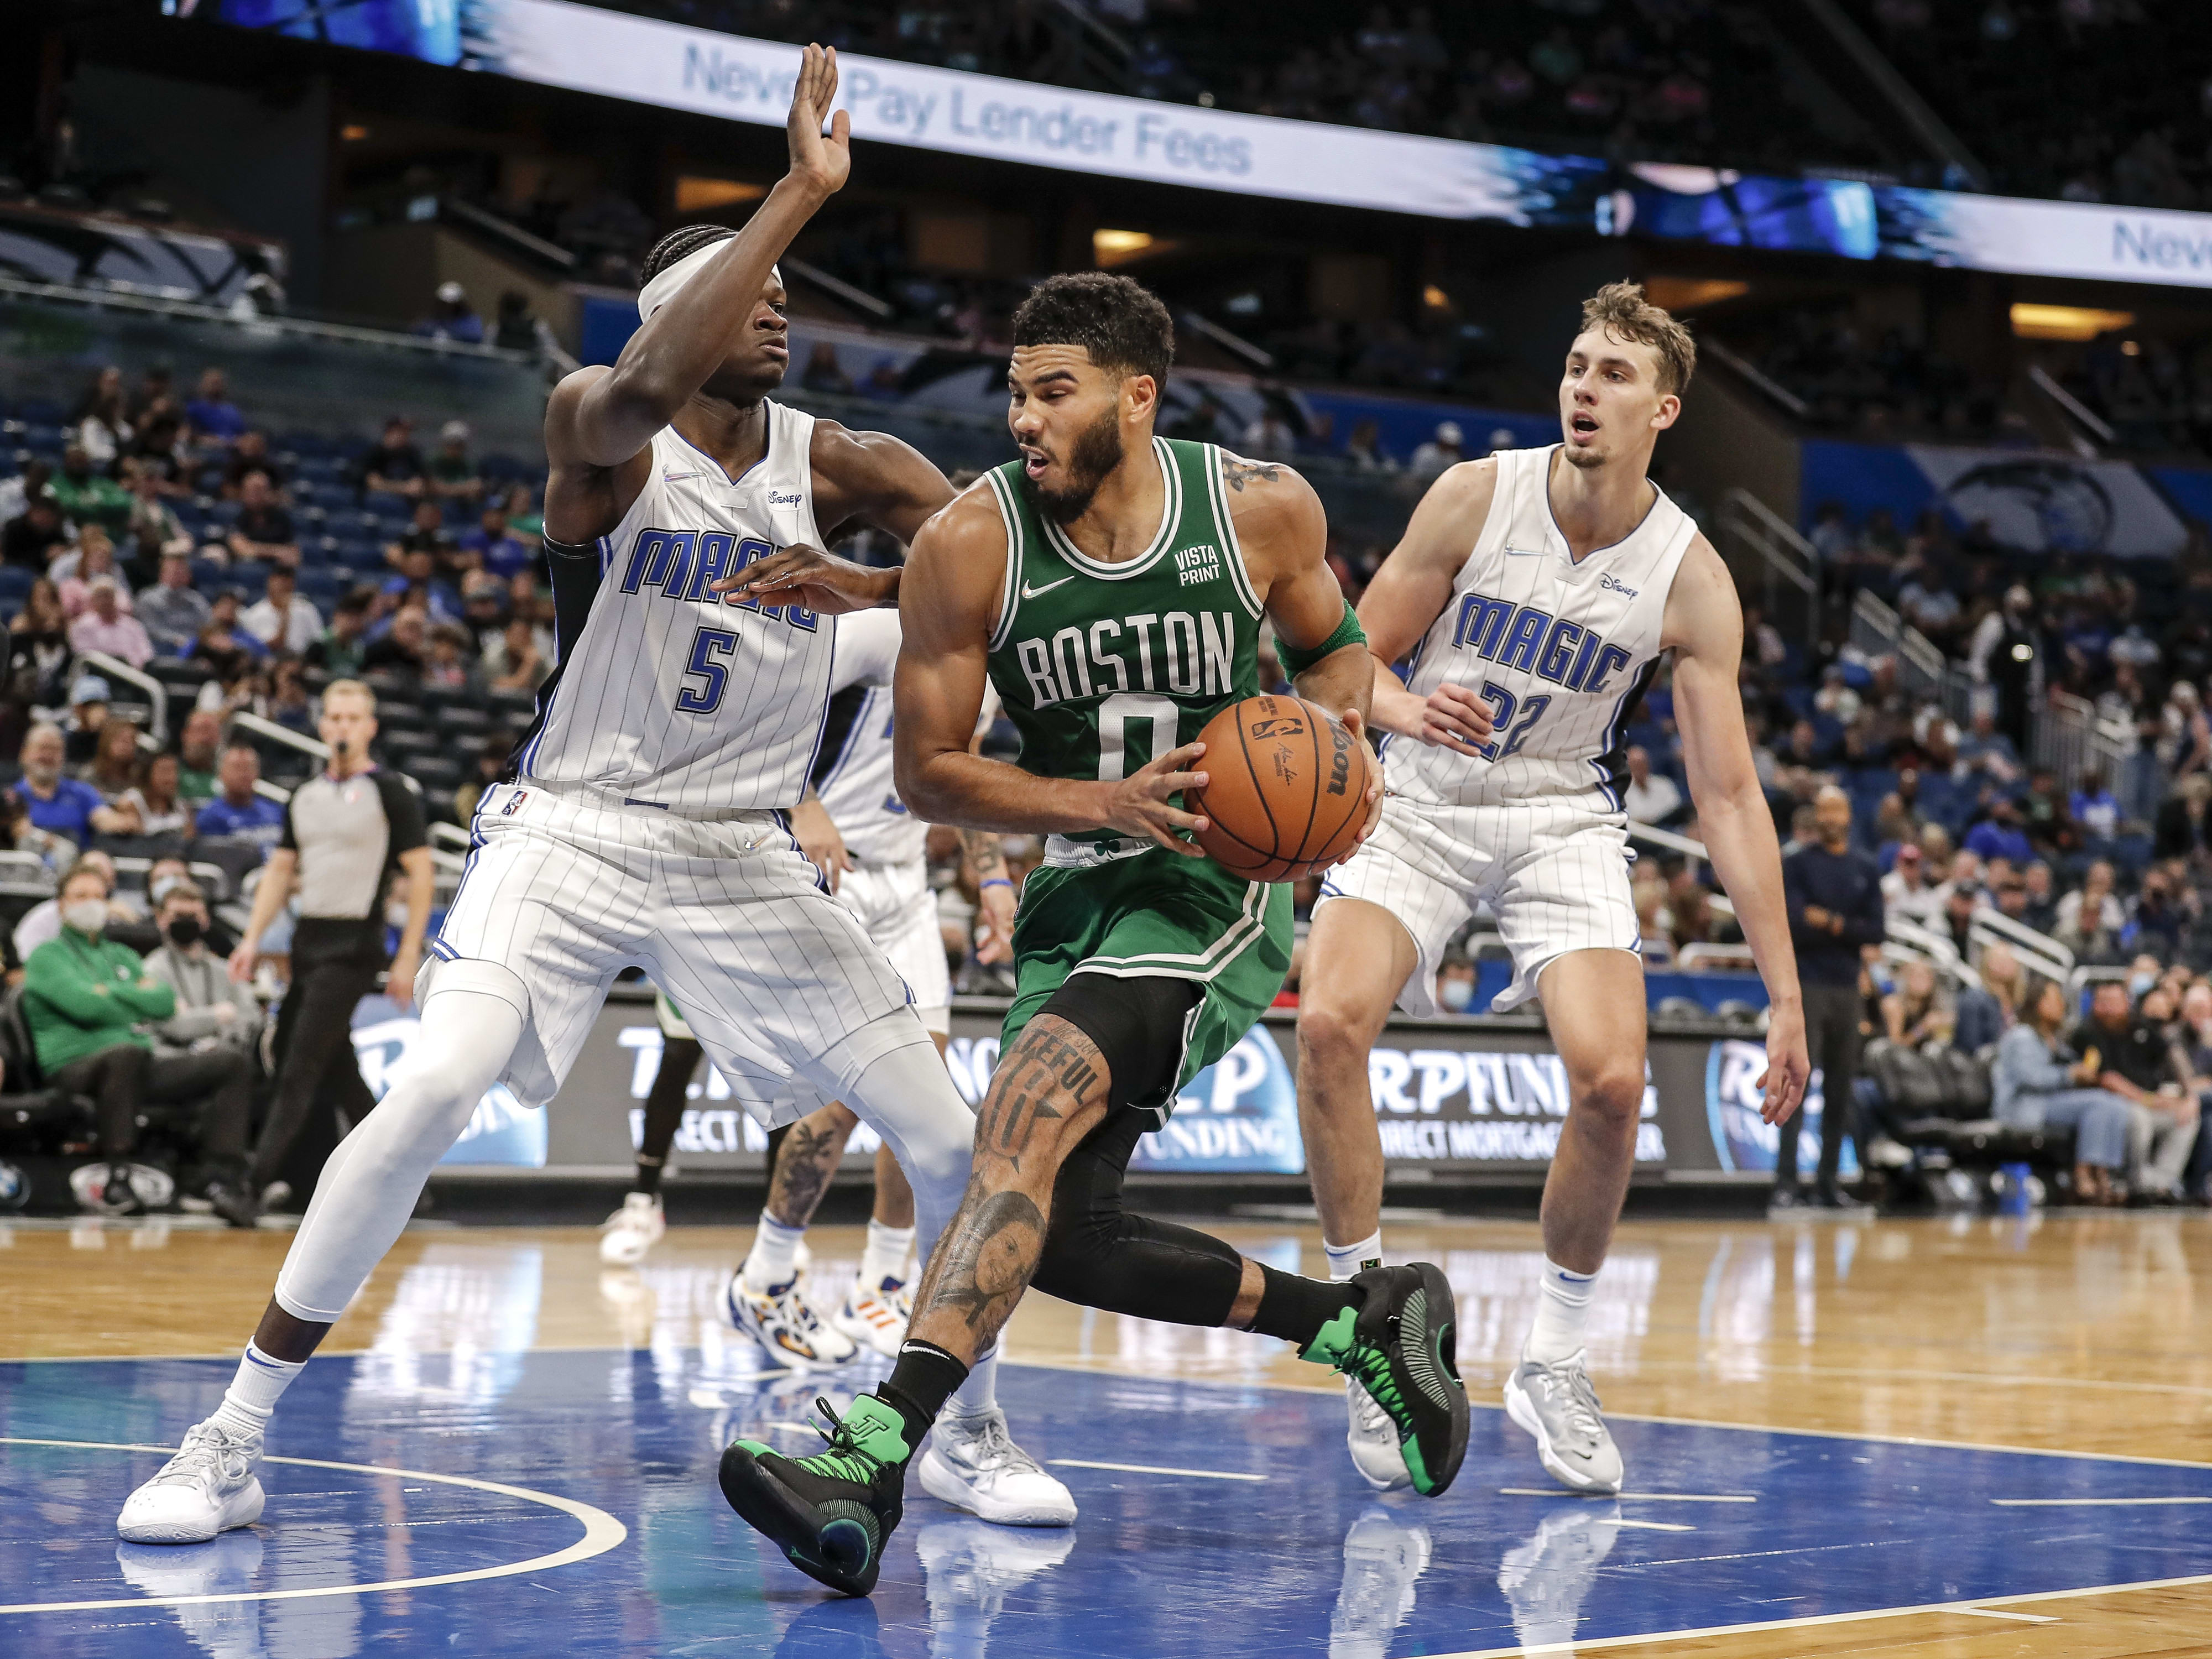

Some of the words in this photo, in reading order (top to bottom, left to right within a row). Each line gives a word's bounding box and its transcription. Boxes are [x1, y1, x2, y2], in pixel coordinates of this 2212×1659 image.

[684, 42, 799, 109] Neve
[845, 66, 938, 136] Pay
[949, 85, 1121, 156] Lender
[1135, 113, 1252, 177] Fees
[1174, 545, 1219, 571] VISTA
[1179, 564, 1220, 586] PRINT
[675, 626, 739, 714] 5
[1016, 611, 1234, 710] BOSTON
[1452, 592, 1632, 693] MAGIC
[1098, 693, 1179, 781] 0
[1462, 680, 1552, 764] 22
[1015, 1028, 1098, 1105] TEFUL
[1131, 1117, 1287, 1160] UNDING
